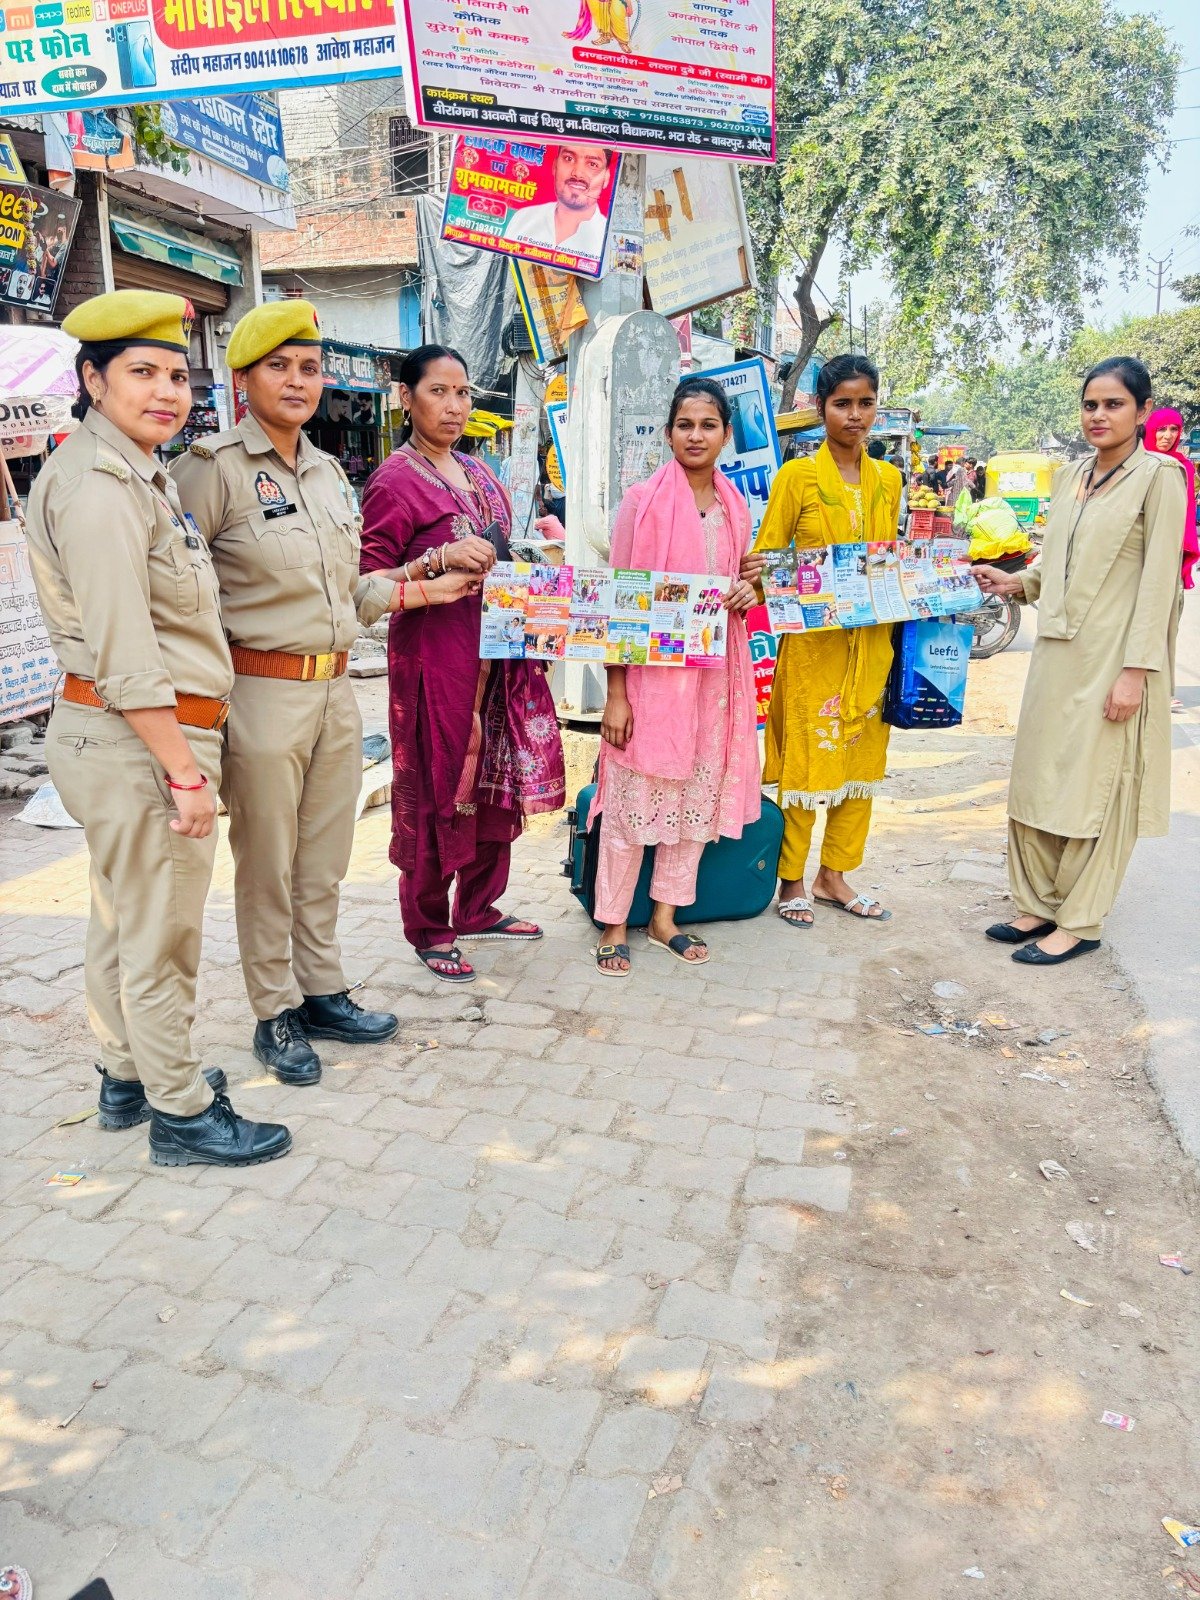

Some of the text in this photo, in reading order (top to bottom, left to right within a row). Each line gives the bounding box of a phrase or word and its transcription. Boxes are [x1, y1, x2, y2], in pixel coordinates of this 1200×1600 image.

[66, 5, 91, 18] realme
[110, 1, 147, 15] ONEPLUS
[512, 4, 530, 15] जी
[452, 11, 502, 26] कौमिक
[668, 11, 759, 33] जगमोहन सिंह जी
[425, 21, 460, 34] सुरेश
[465, 26, 483, 37] जी
[699, 27, 729, 39] वादक
[5, 28, 91, 63] पर फोन
[671, 34, 757, 56] गोपाल द्विवेदी जी
[170, 34, 395, 76] संदीप महाजन 9041410678 आवेश महाजन
[637, 80, 649, 88] जी
[698, 68, 712, 78] जी
[750, 76, 768, 87] जी)
[23, 80, 37, 96] पर
[532, 85, 545, 95] श्री
[550, 87, 596, 100] रामलीला
[600, 93, 630, 104] कमेटी
[426, 87, 494, 106] कार्यक्रम स्थल
[575, 103, 609, 117] सम्पर्क
[433, 100, 479, 120] वीरांगना
[481, 107, 518, 125] अवन्ती
[519, 112, 539, 128] बाई
[541, 115, 564, 134] शिशु
[687, 130, 702, 145] रोड
[490, 159, 508, 175] एवं
[801, 571, 815, 580] 181
